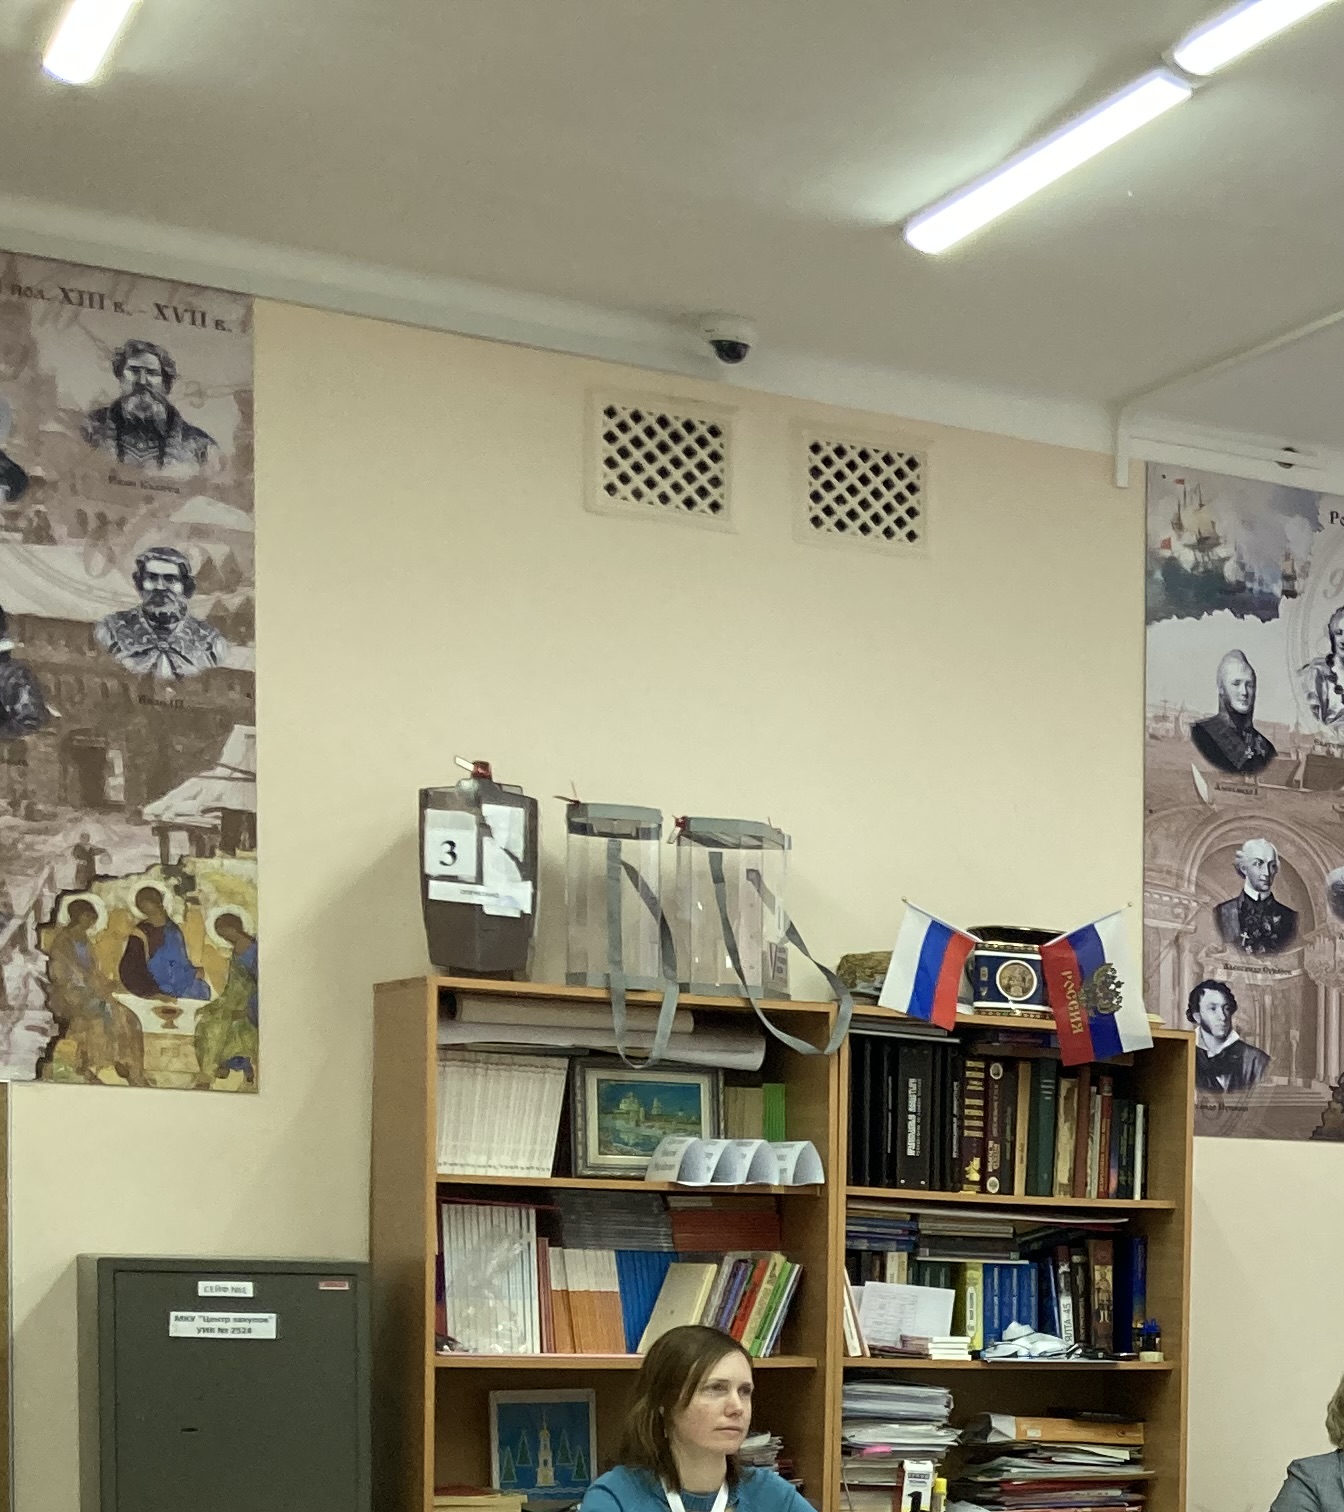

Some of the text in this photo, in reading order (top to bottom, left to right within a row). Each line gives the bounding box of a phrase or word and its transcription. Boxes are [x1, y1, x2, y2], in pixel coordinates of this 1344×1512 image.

[57, 285, 106, 311] XIII
[113, 300, 133, 316] в.
[153, 302, 207, 329] XVII
[214, 317, 233, 333] в.
[439, 840, 457, 868] 3
[1060, 969, 1084, 1036] РОССИЯ
